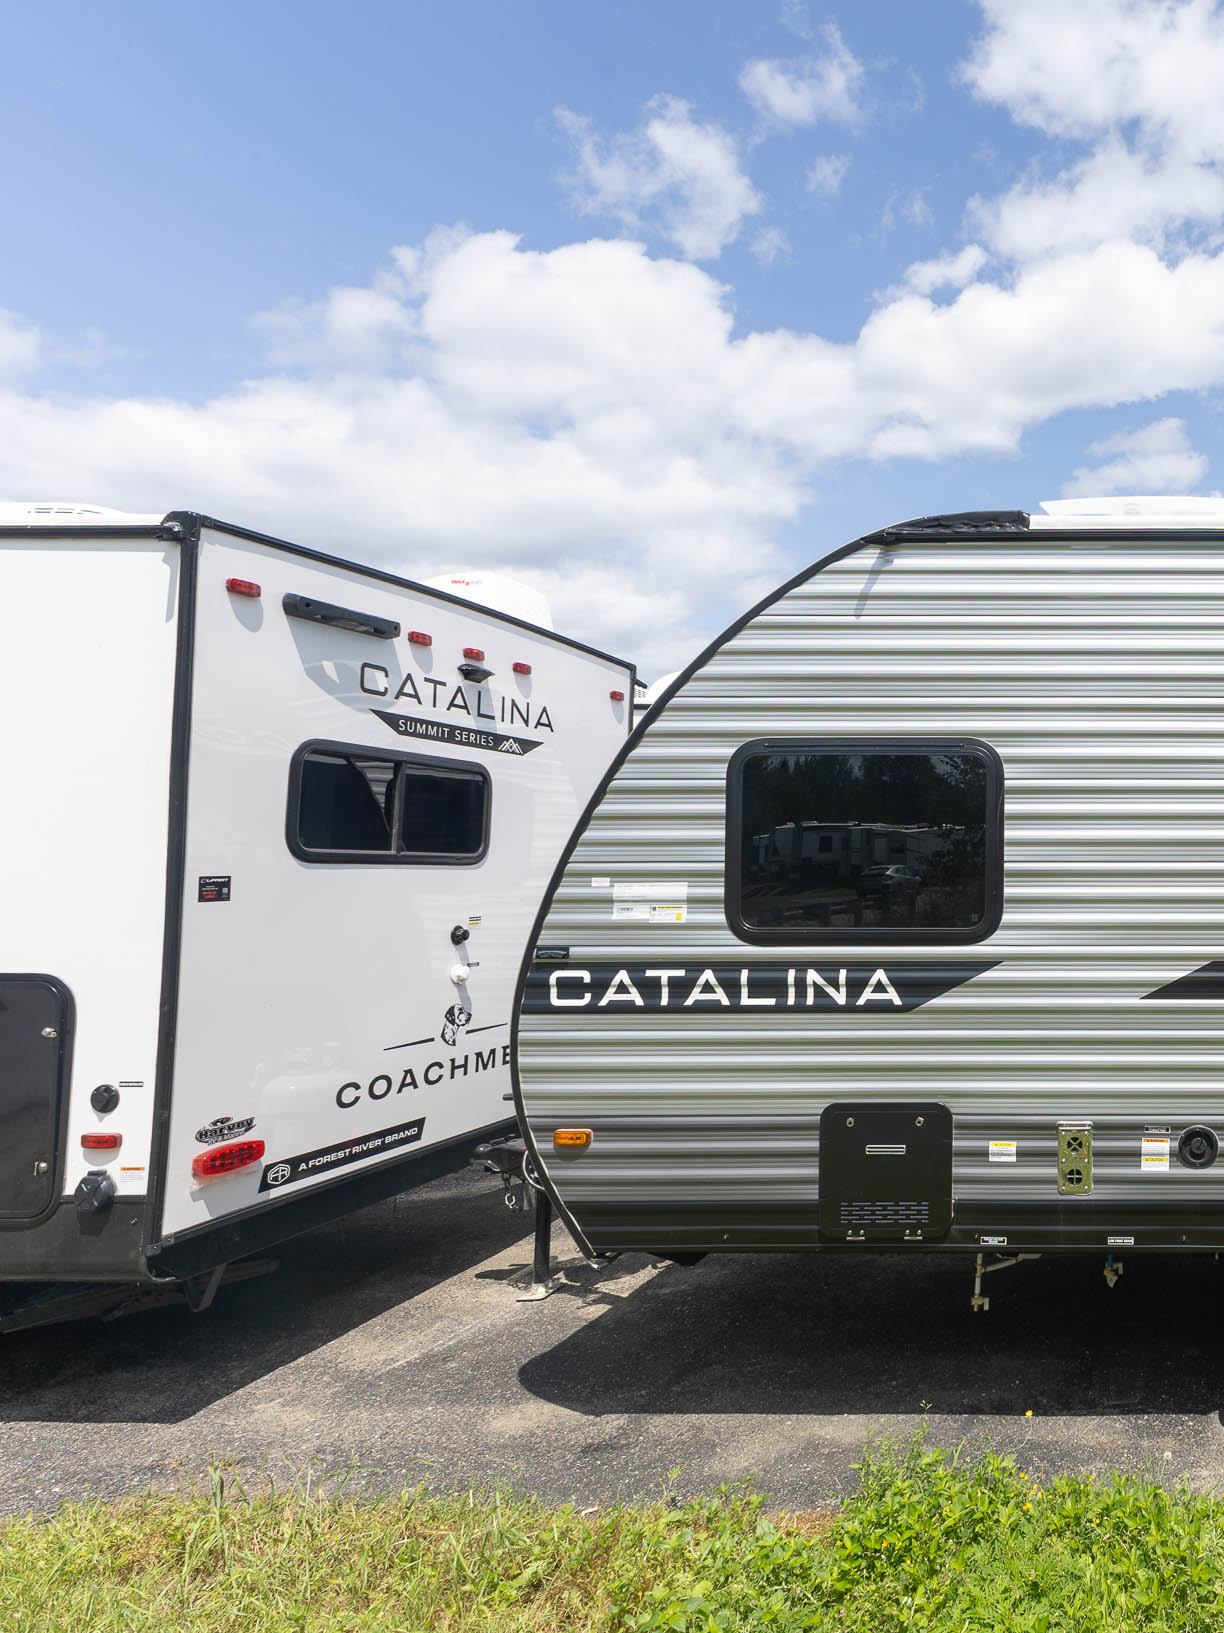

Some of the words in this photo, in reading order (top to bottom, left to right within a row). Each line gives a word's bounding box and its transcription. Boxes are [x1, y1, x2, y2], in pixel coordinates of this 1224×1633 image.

[360, 662, 554, 733] CATALINA
[398, 719, 450, 739] SUMMIT
[454, 729, 495, 746] SERIES
[549, 968, 903, 1007] CATALINA
[298, 1162, 308, 1172] A
[308, 1148, 351, 1169] FOREST
[384, 1127, 418, 1144] BRAND
